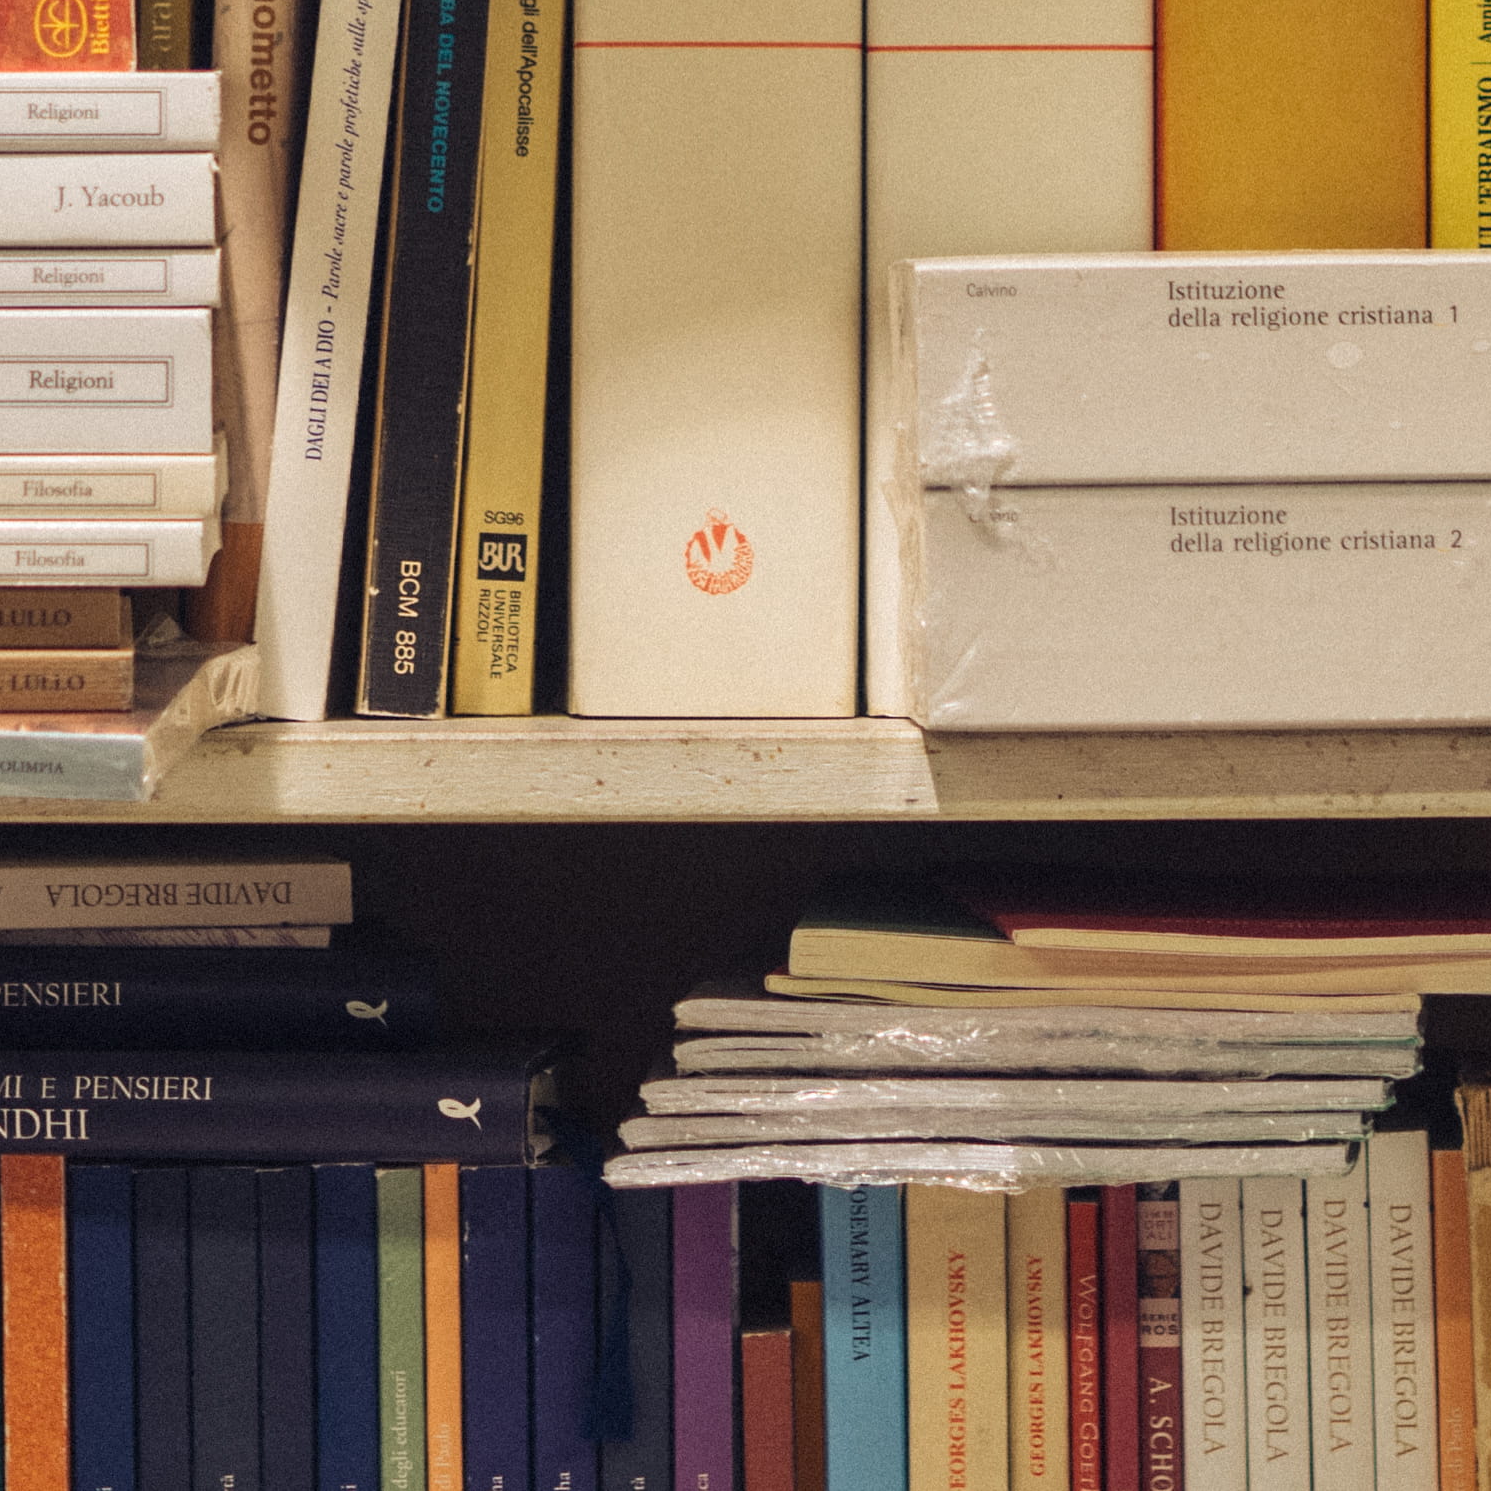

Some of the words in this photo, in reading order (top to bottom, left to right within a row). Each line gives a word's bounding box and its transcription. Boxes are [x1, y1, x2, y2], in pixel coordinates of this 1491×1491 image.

[28, 104, 99, 123] Religioni
[54, 186, 72, 213] J.
[82, 185, 165, 207] Yacoub
[1168, 280, 1285, 300] Istituzione
[1168, 307, 1220, 327] della
[1231, 306, 1329, 331] religione
[1338, 305, 1433, 325] cristiana
[1449, 305, 1458, 326] 1
[477, 589, 491, 642] RIZZOLI
[490, 590, 506, 678] UNIVERSALE
[507, 590, 521, 672] BIBLIOTECA
[41, 1078, 55, 1099] E
[75, 1076, 211, 1100] PENSIERI
[1027, 1255, 1044, 1376] LAKHOVSKY
[1030, 1383, 1044, 1476] GEORGES
